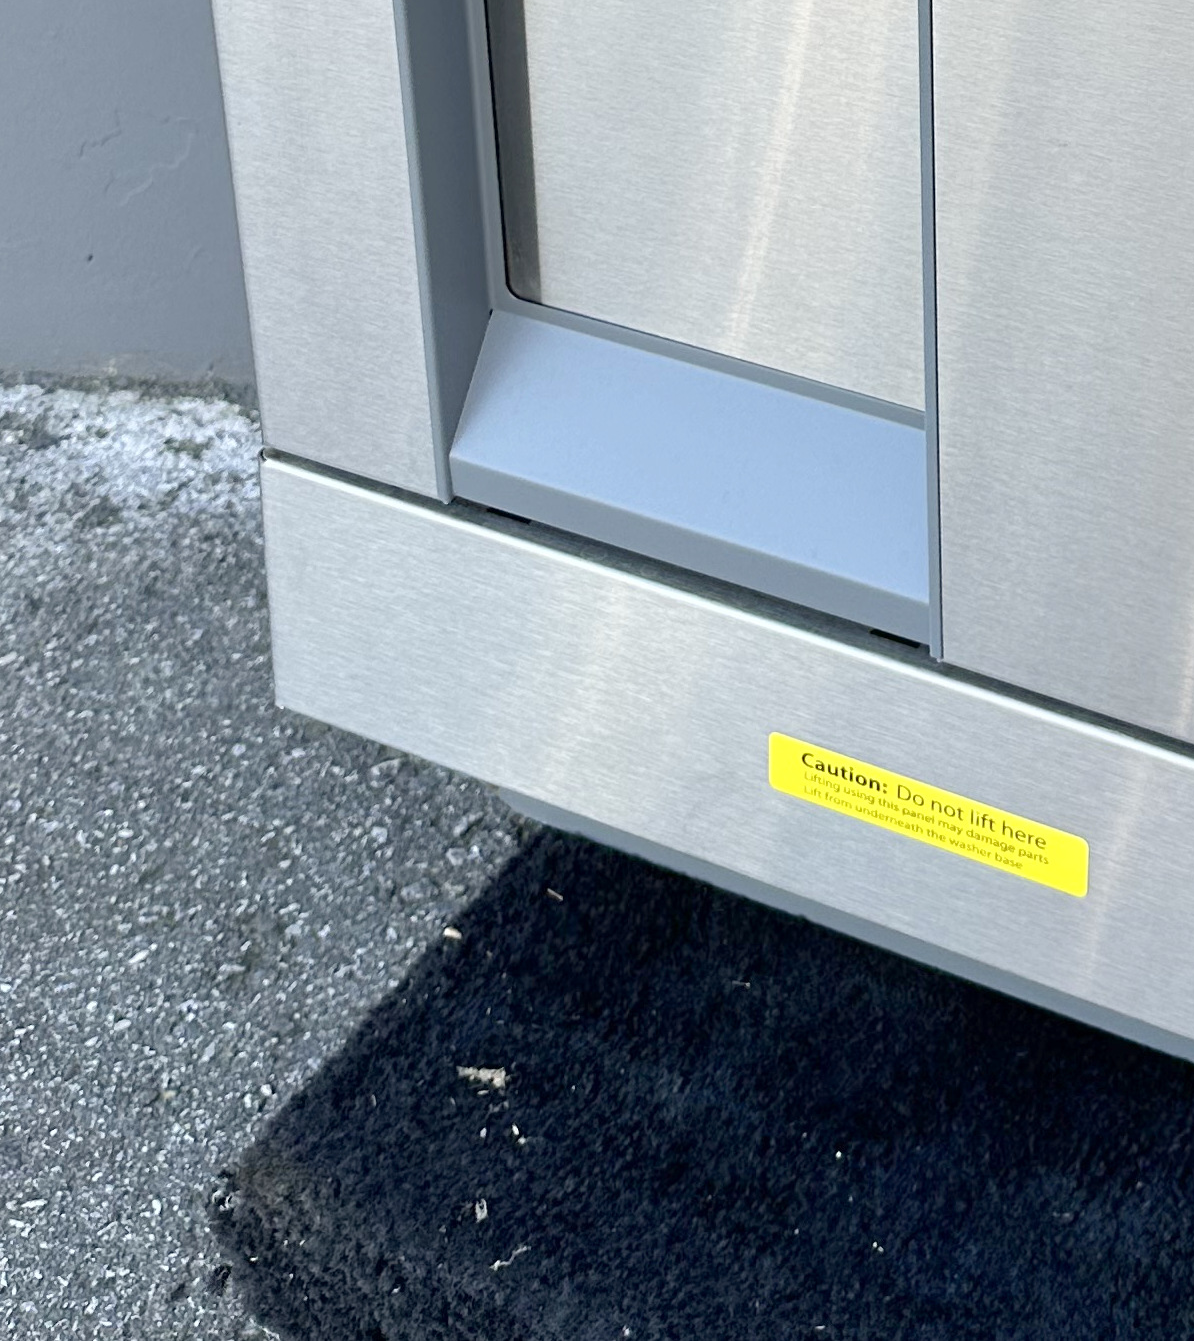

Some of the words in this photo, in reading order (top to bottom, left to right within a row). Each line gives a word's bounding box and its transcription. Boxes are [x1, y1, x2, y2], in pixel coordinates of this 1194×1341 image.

[801, 752, 888, 795] Caution:
[897, 784, 925, 807] Do
[931, 799, 964, 821] not
[970, 808, 996, 833] lift
[1002, 820, 1047, 850] here
[804, 771, 841, 793] Lifting
[843, 786, 875, 805] using
[878, 797, 900, 812] this
[901, 807, 935, 825] panel
[938, 819, 963, 835] may
[966, 829, 1016, 853] damage
[1018, 848, 1049, 865] parts
[804, 785, 821, 799] Lift
[825, 792, 853, 809] from
[855, 805, 924, 835] underneath
[926, 828, 946, 843] the
[949, 837, 992, 859] washer
